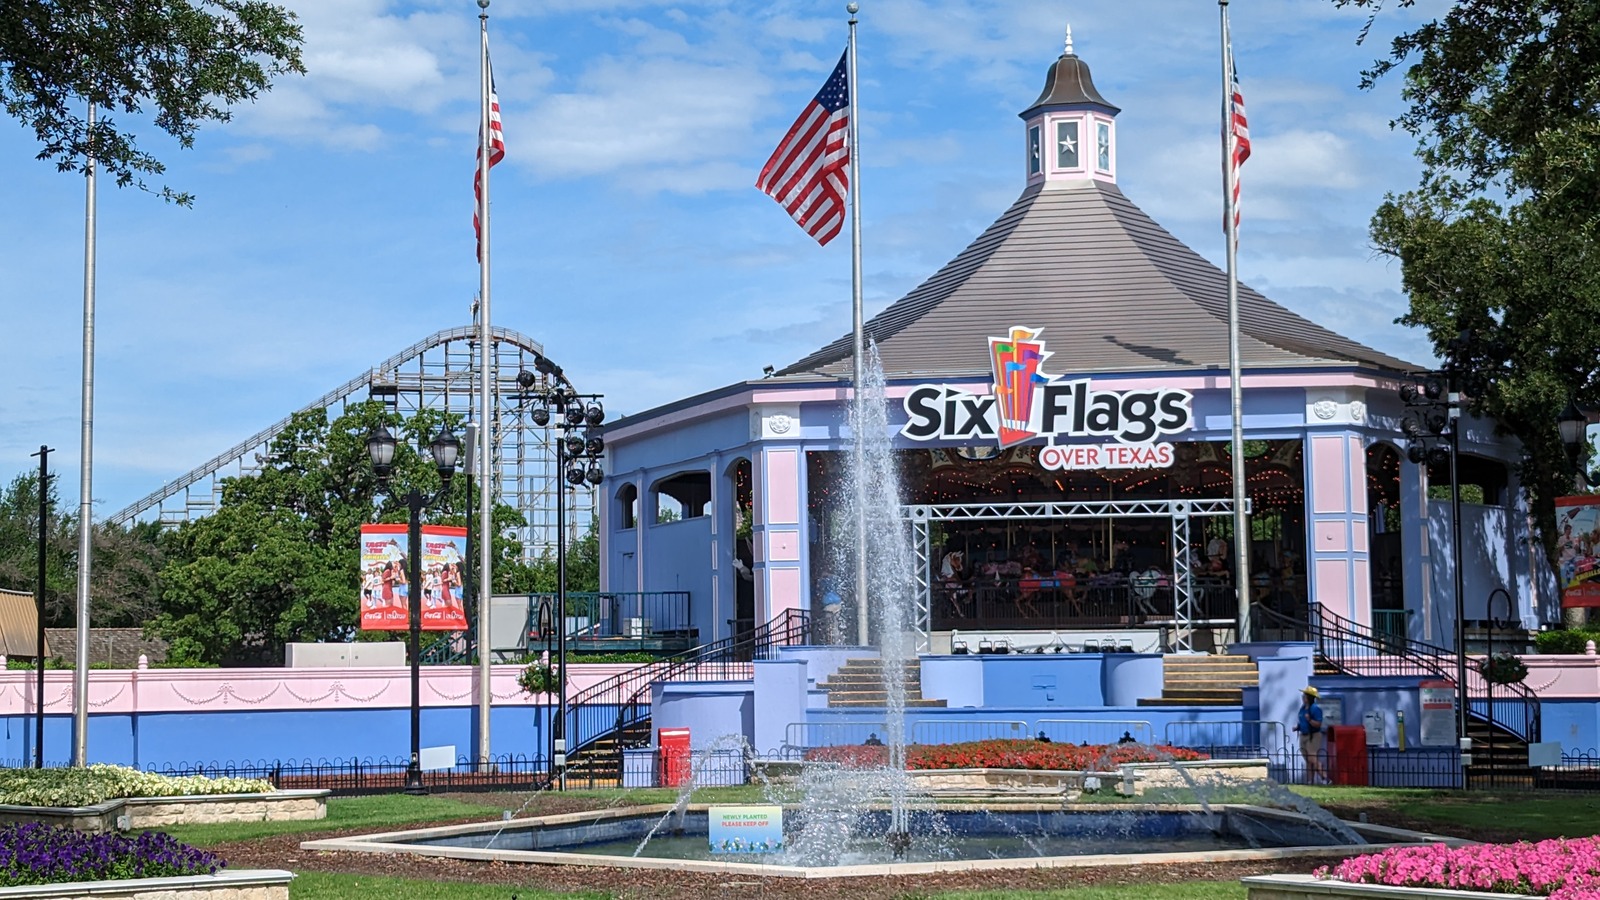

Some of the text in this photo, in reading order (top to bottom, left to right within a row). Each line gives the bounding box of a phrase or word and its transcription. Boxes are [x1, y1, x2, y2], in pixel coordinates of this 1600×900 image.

[906, 382, 1189, 443] Six Flags
[1042, 446, 1170, 466] OVER TEXAS
